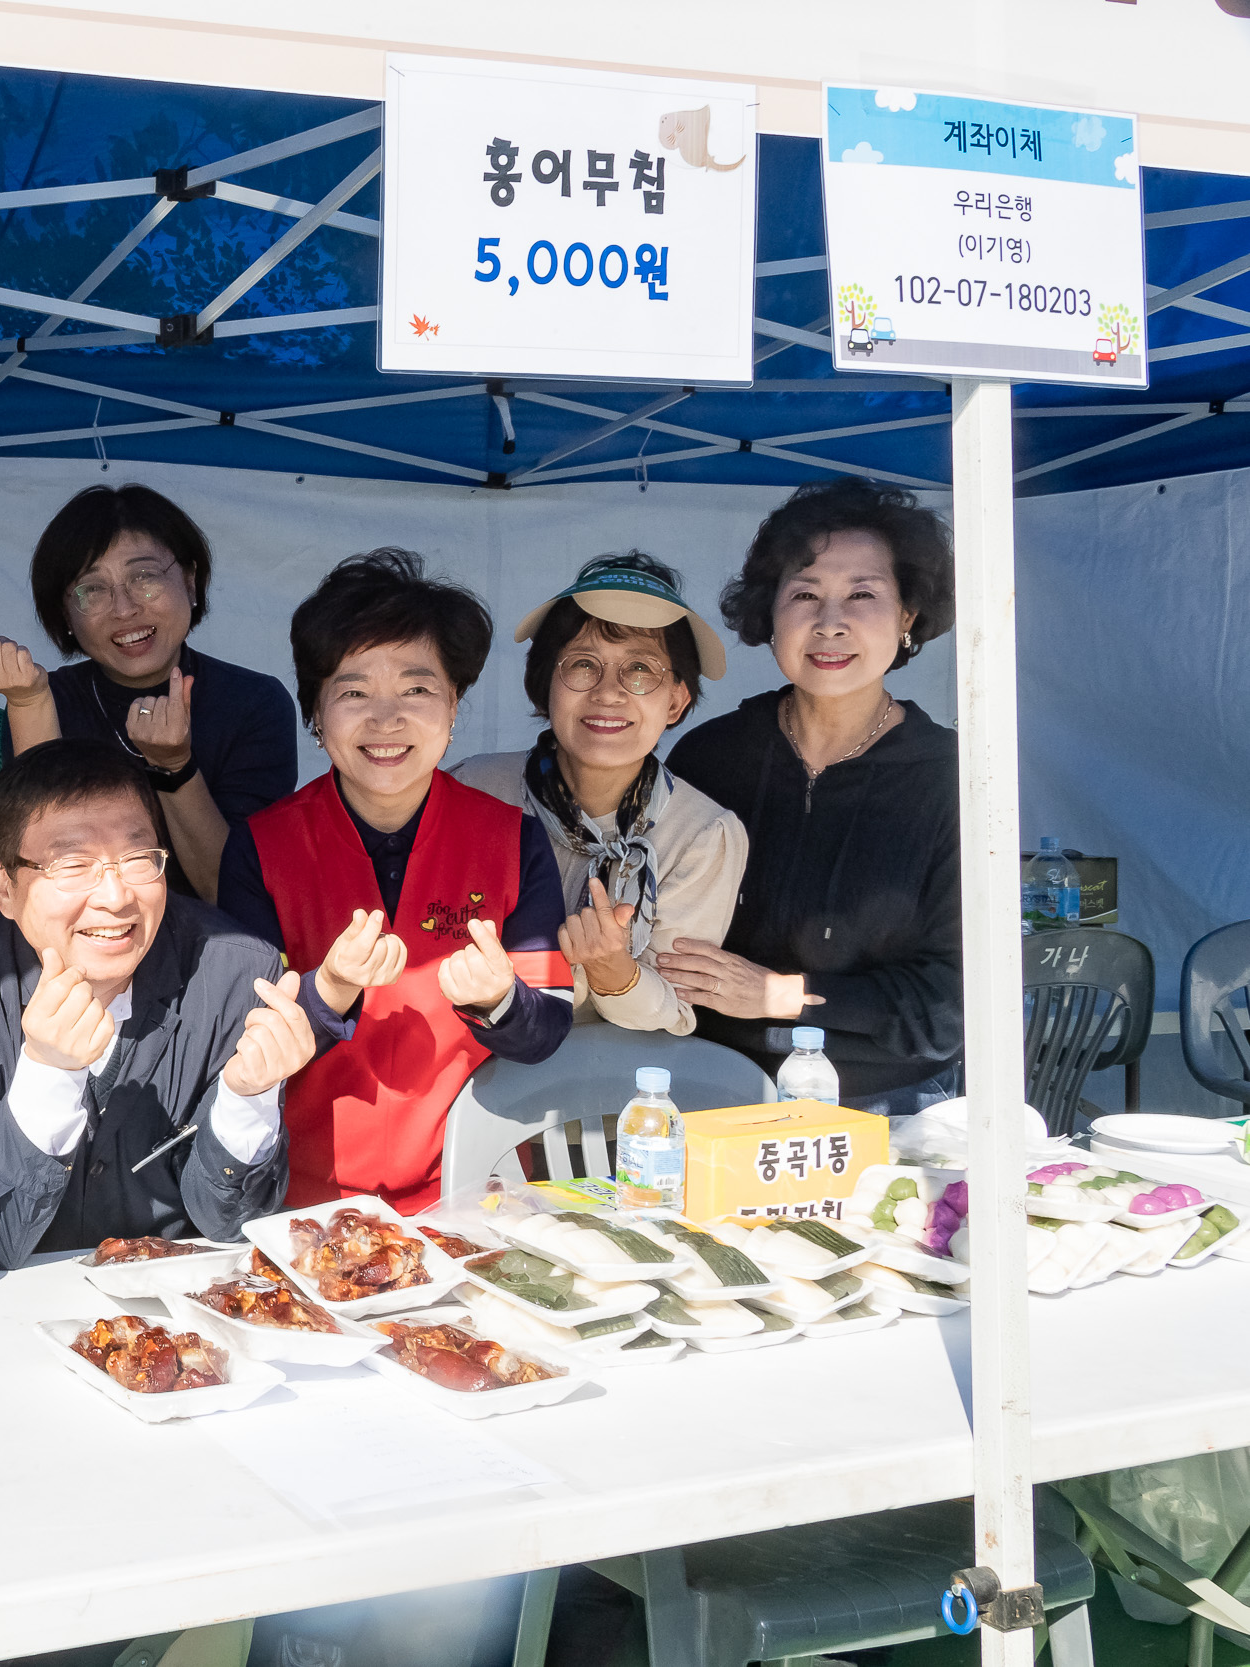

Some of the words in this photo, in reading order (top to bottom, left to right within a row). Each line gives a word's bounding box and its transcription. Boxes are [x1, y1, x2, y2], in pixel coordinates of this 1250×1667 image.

[943, 118, 1044, 162] 계좌이체
[484, 137, 666, 215] 홍어무침
[953, 190, 1033, 223] 우리은행
[475, 237, 670, 302] 5,000원
[958, 234, 1032, 265] (이기영)
[895, 275, 1092, 318] 102-07-180203
[428, 900, 451, 915] Too
[758, 1135, 849, 1182] 중곡1동
